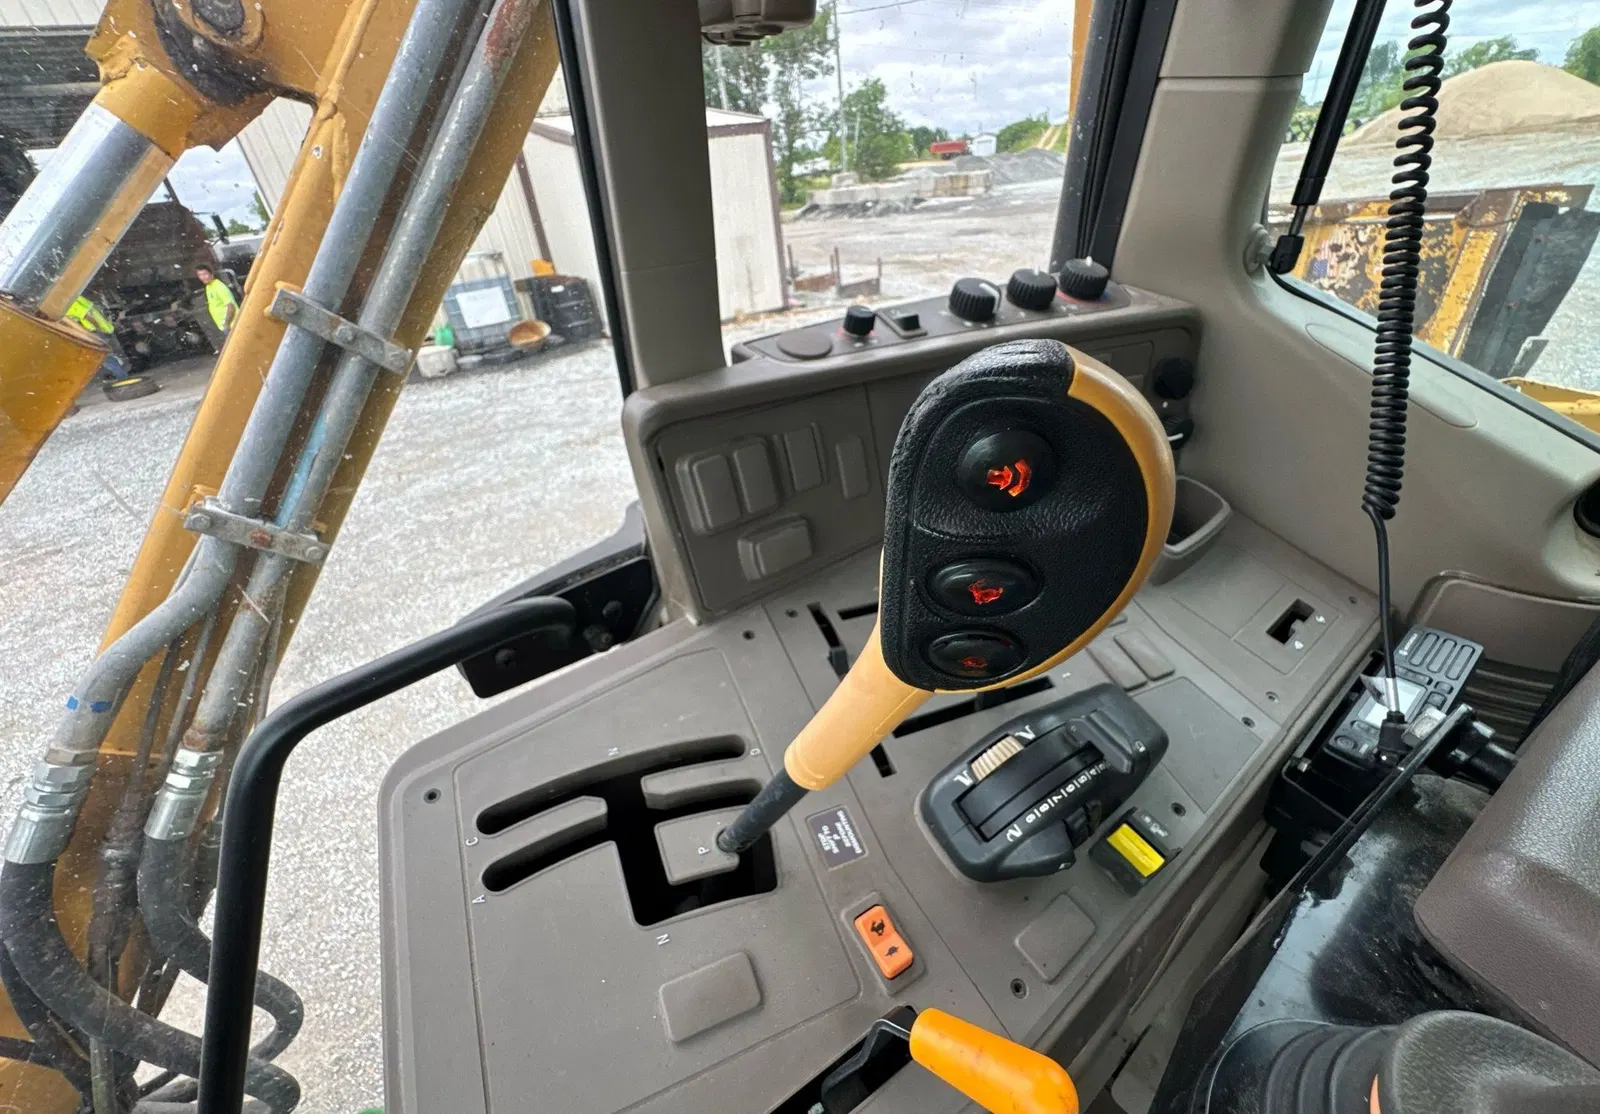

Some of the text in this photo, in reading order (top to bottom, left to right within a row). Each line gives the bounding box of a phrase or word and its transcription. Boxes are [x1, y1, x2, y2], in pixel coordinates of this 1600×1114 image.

[822, 825, 830, 835] TO
[834, 822, 851, 847] BEFORE
[837, 810, 862, 853] DISMOUNTING
[466, 837, 478, 846] C
[818, 832, 831, 850] STOP
[698, 847, 710, 855] P
[472, 894, 485, 903] A
[656, 933, 670, 945] N
